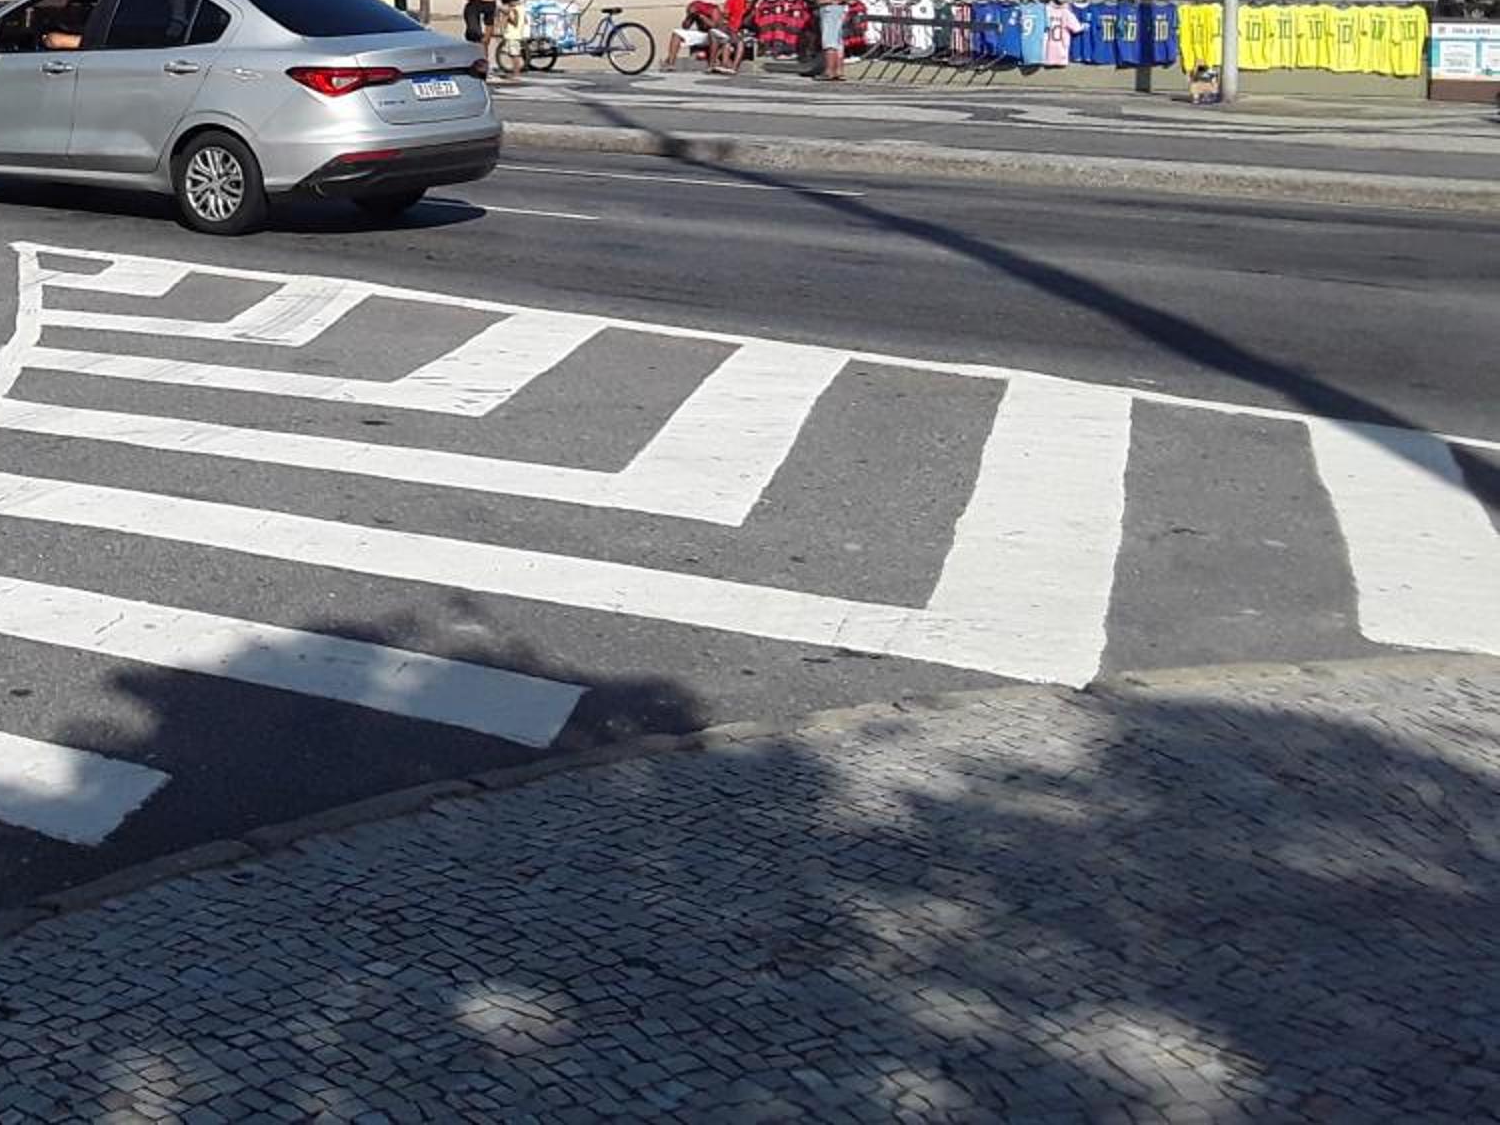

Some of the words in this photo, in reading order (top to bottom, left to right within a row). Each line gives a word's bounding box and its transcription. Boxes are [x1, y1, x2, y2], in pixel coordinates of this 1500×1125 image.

[1023, 18, 1033, 36] 9
[1155, 21, 1168, 42] 10
[1245, 21, 1260, 41] 10
